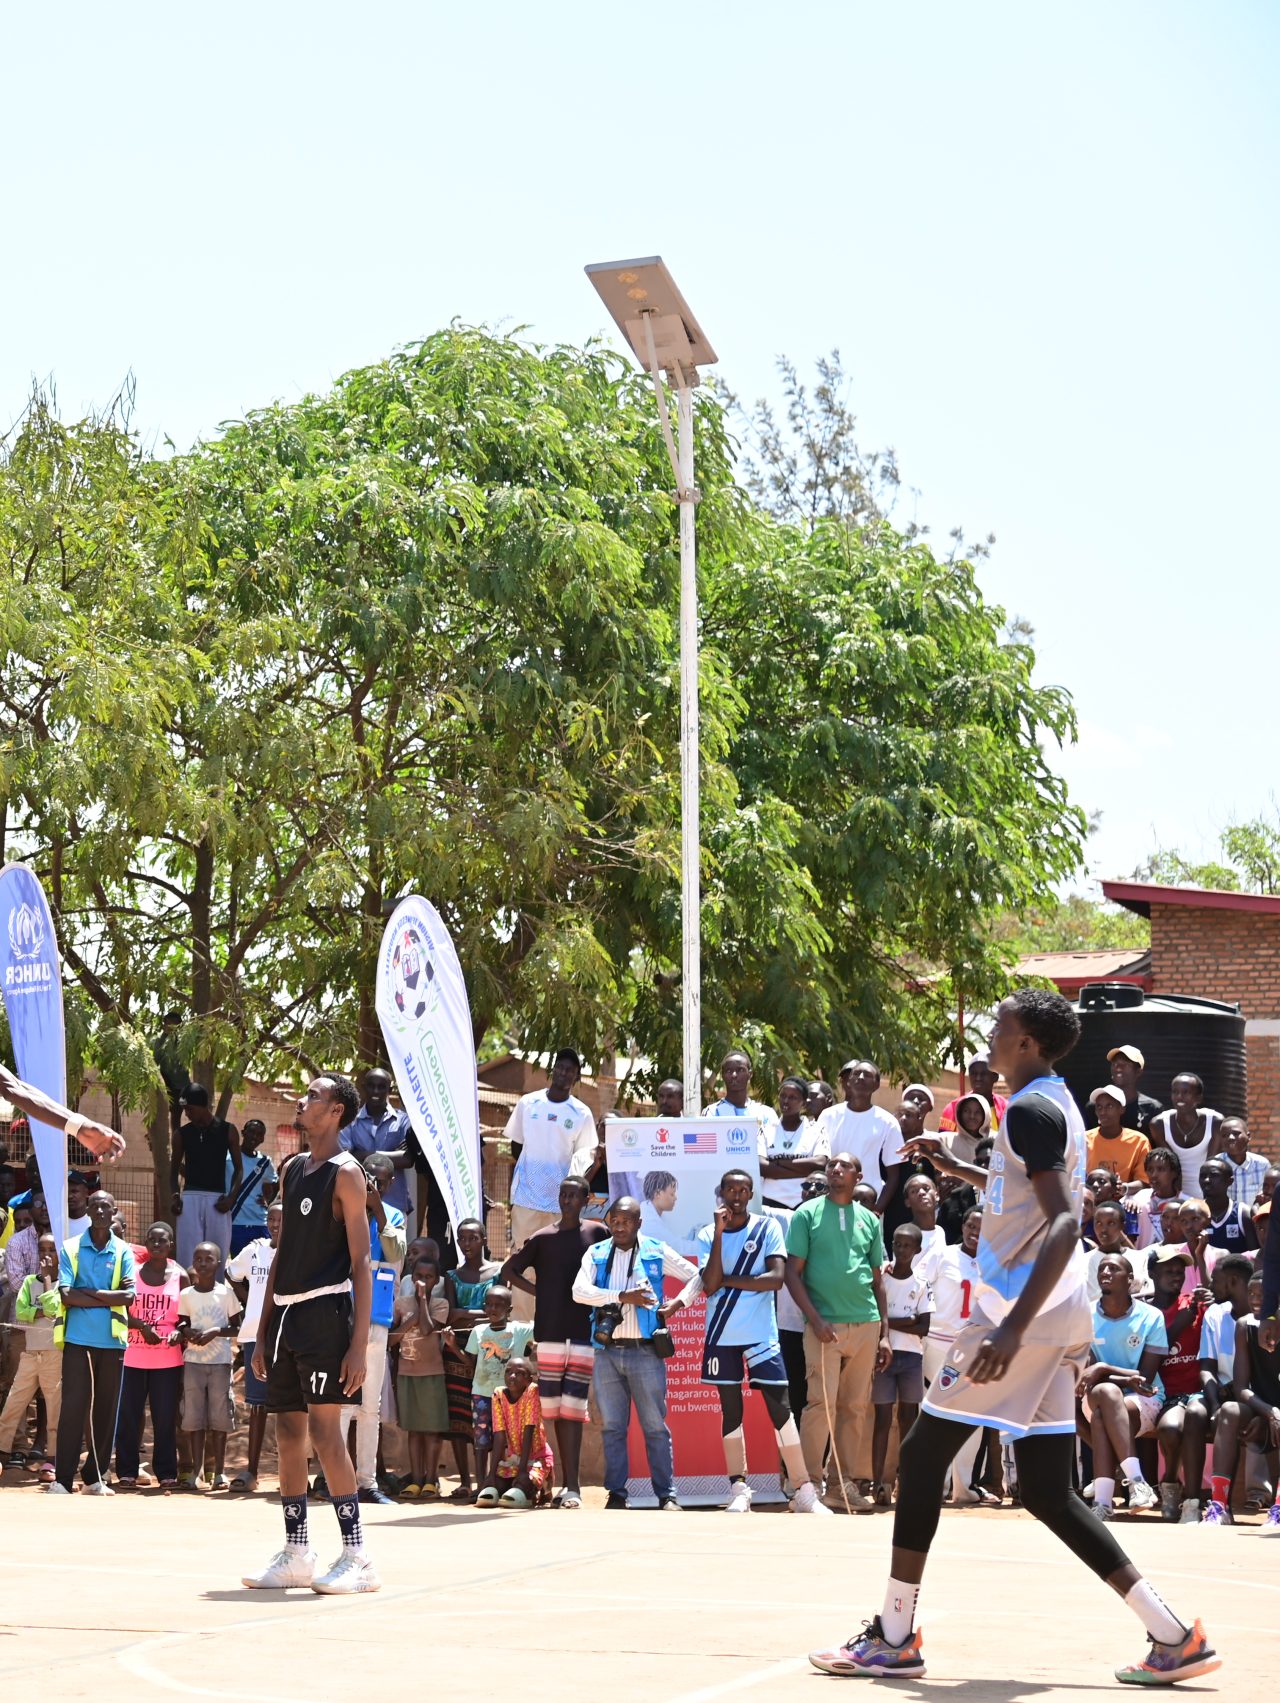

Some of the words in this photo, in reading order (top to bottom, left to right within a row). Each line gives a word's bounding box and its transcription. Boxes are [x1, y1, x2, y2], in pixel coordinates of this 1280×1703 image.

[988, 1175, 1004, 1215] 4
[134, 1293, 172, 1311] FIGHT
[960, 1279, 972, 1319] 1
[137, 1310, 158, 1321] LIKE
[686, 1362, 702, 1372] ind
[707, 1357, 719, 1376] 10
[310, 1371, 328, 1396] 17
[665, 1388, 710, 1400] hagararo
[671, 1404, 686, 1412] mu
